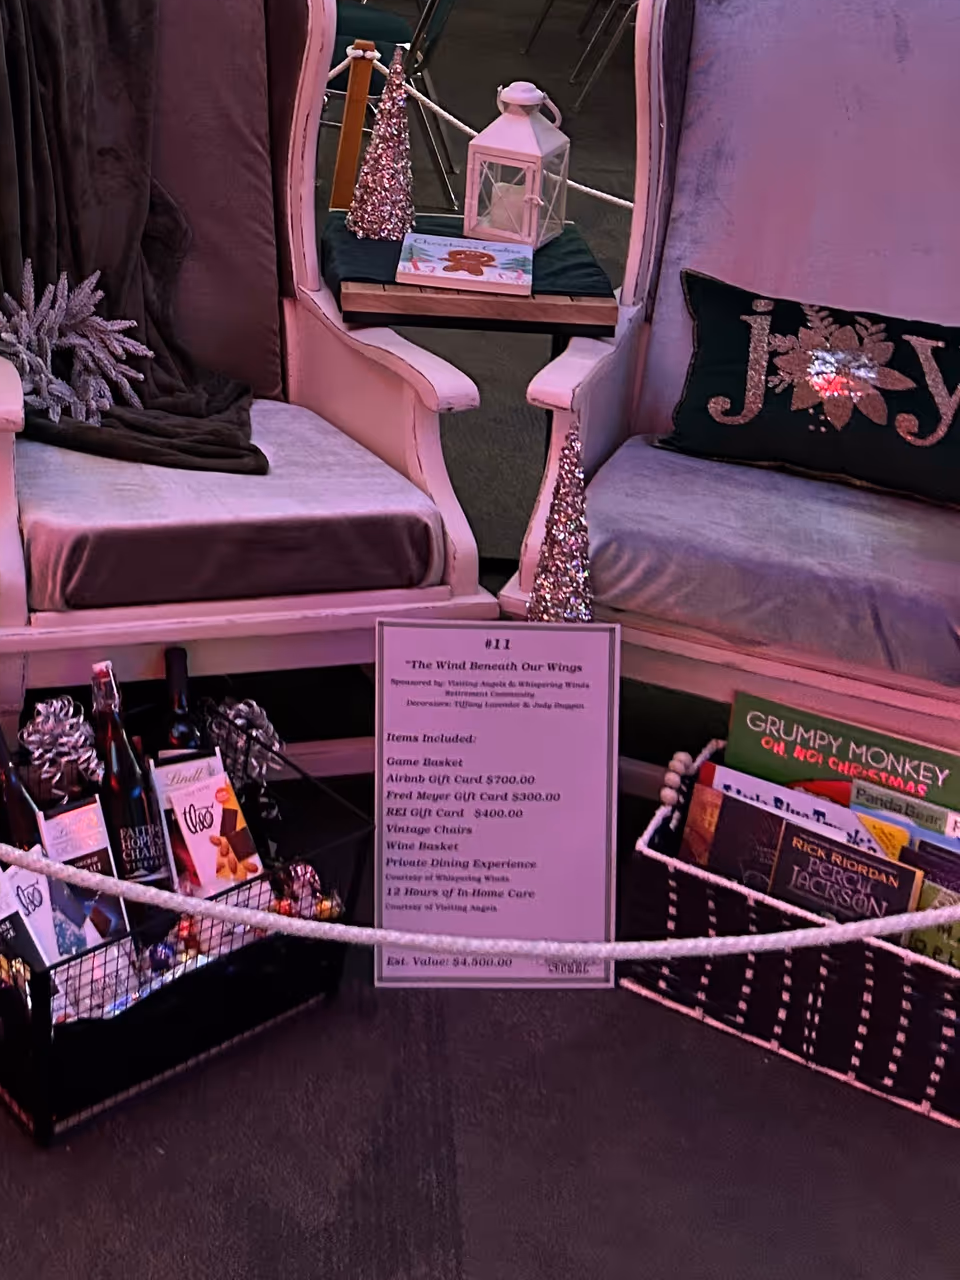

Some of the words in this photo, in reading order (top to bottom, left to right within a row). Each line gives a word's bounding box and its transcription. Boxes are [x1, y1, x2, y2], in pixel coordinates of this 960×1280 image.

[436, 661, 466, 671] Wind
[469, 661, 517, 672] Beneath
[521, 663, 544, 672] Our
[547, 663, 583, 673] Wings
[386, 733, 419, 743] Items
[422, 734, 477, 744] Included:
[746, 711, 843, 754] GRUMPY
[848, 740, 950, 787] MONKEY
[386, 757, 420, 767] Game
[422, 758, 463, 768] Basket
[386, 774, 425, 784] Airbnb
[428, 775, 451, 786] Gift
[454, 775, 483, 785] Card
[485, 776, 536, 786] $700.00
[828, 756, 928, 798] CHRISTMAS
[386, 791, 412, 801] Fred
[416, 792, 451, 803] Meyer
[454, 793, 476, 803] Gift
[479, 793, 509, 803] Card
[512, 793, 561, 803] $300.00
[855, 787, 903, 815] Panda
[386, 808, 408, 818] REI
[410, 809, 433, 819] Gift
[436, 809, 465, 819] Card
[473, 809, 524, 819] $400.00
[386, 825, 431, 836] Vintage
[434, 825, 473, 835] Chairs
[386, 841, 415, 851] Wine
[418, 842, 459, 852] Basket
[385, 857, 427, 868] Private
[431, 858, 470, 869] Dining
[473, 859, 537, 869] Experience
[792, 836, 826, 860] RICK
[831, 851, 900, 889] RIORDAN
[387, 888, 401, 897] 12
[404, 888, 439, 897] Hours
[442, 888, 454, 898] of
[508, 889, 536, 898] Care
[788, 864, 889, 918] JACKSON
[387, 956, 406, 966] Est.
[413, 957, 449, 966] Value:
